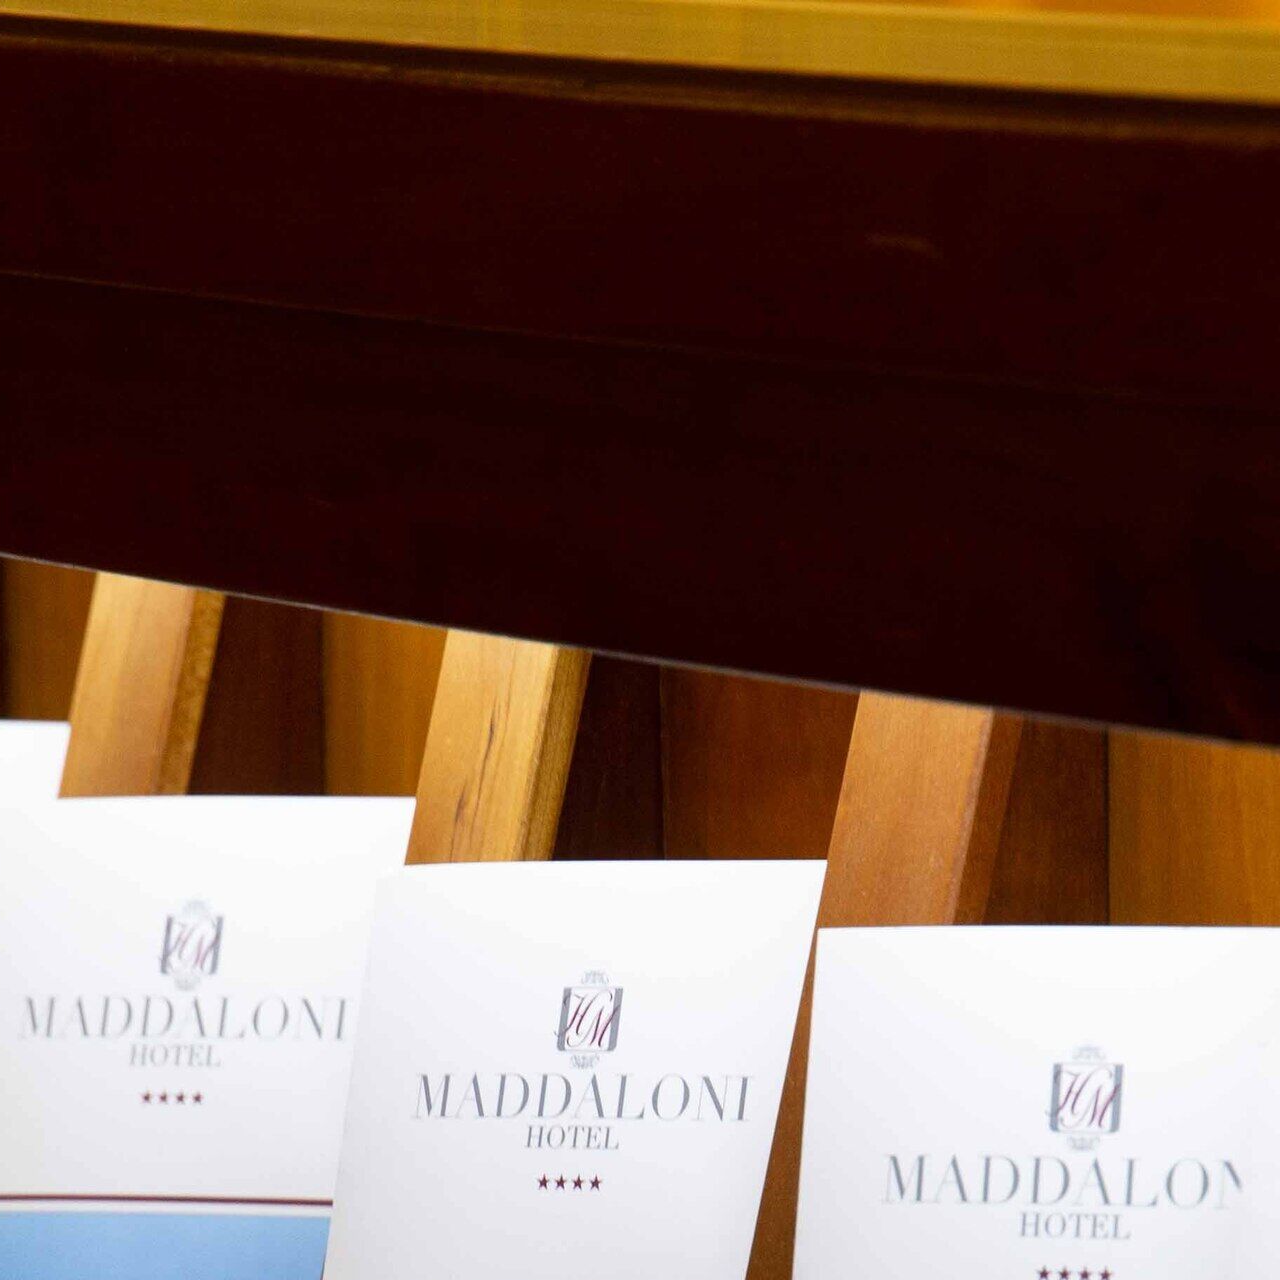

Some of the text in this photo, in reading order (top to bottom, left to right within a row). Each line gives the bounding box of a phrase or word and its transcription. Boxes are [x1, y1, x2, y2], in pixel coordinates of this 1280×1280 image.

[17, 995, 351, 1041] MADDALONI
[128, 1043, 222, 1068] HOTEL
[411, 1072, 754, 1122] MADDALONI
[524, 1125, 620, 1151] HOTEL
[883, 1153, 1243, 1210] MADDALON
[1019, 1211, 1131, 1240] HOTEL
